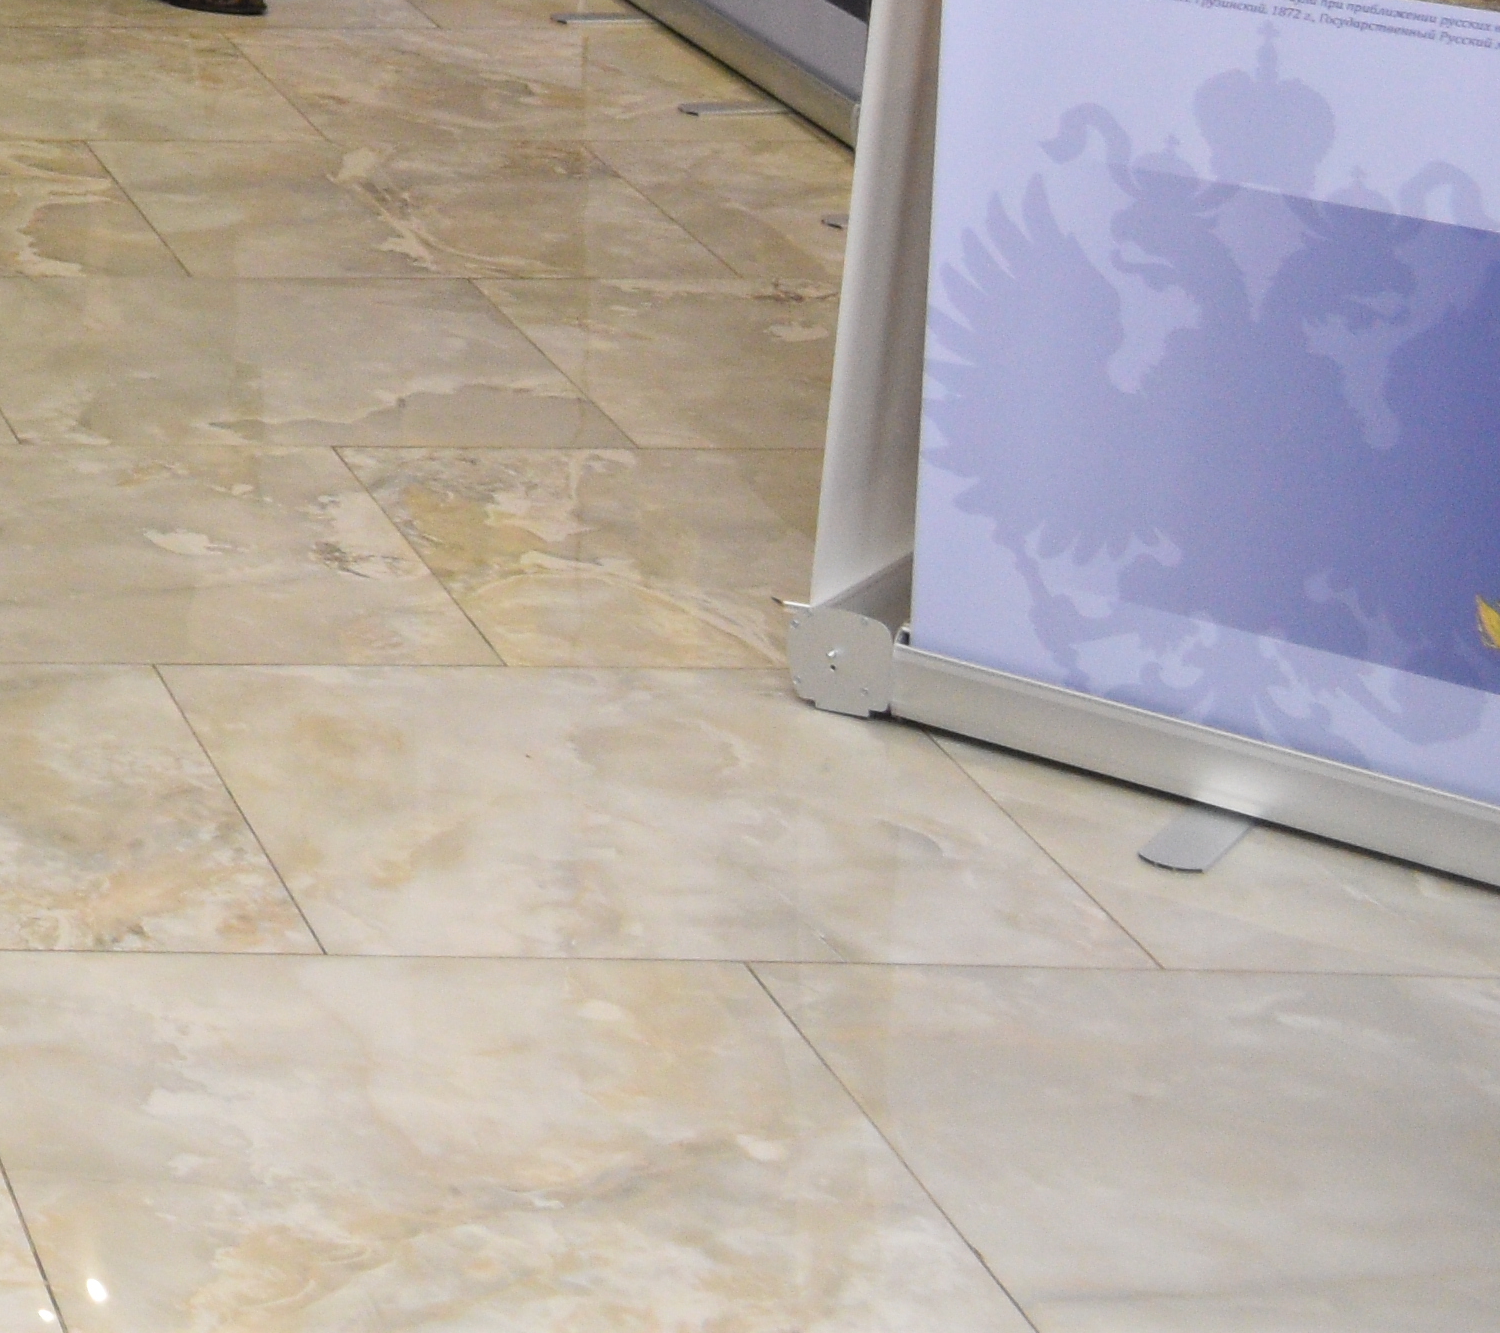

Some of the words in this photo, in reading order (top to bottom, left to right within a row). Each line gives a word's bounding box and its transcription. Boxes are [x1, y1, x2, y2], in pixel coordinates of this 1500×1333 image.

[1271, 4, 1303, 21] 1872
[1318, 11, 1437, 42] Государственный
[1438, 26, 1497, 51] Русский
